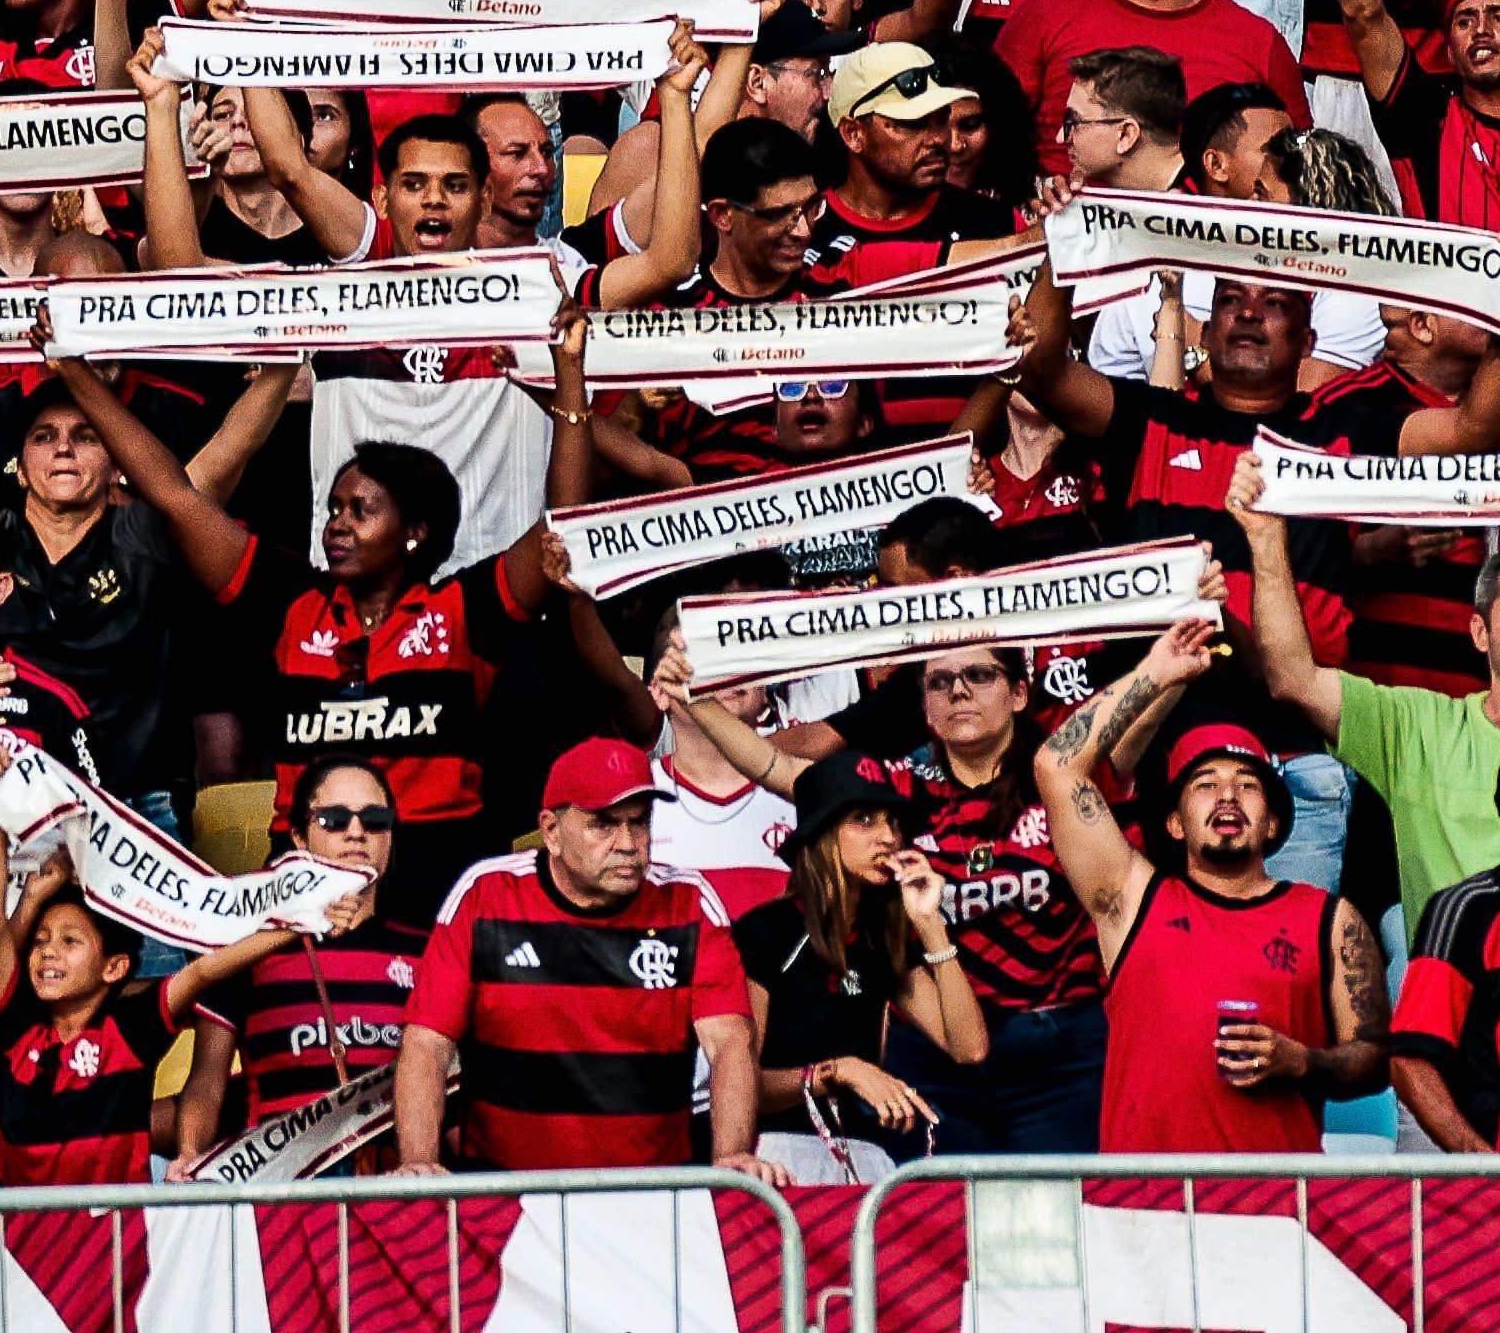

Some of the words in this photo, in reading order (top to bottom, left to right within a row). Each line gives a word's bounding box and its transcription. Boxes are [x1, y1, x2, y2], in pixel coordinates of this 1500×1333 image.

[477, 0, 541, 14] Betano
[80, 295, 135, 323] PRA
[146, 292, 226, 319] CIMA
[237, 286, 327, 316] DELES,
[339, 274, 519, 312] FLAMENGO!
[718, 616, 779, 647] PRA
[786, 605, 871, 637] CIMA
[983, 563, 1172, 617] FLAMENGO!
[287, 696, 443, 744] LUBRAX
